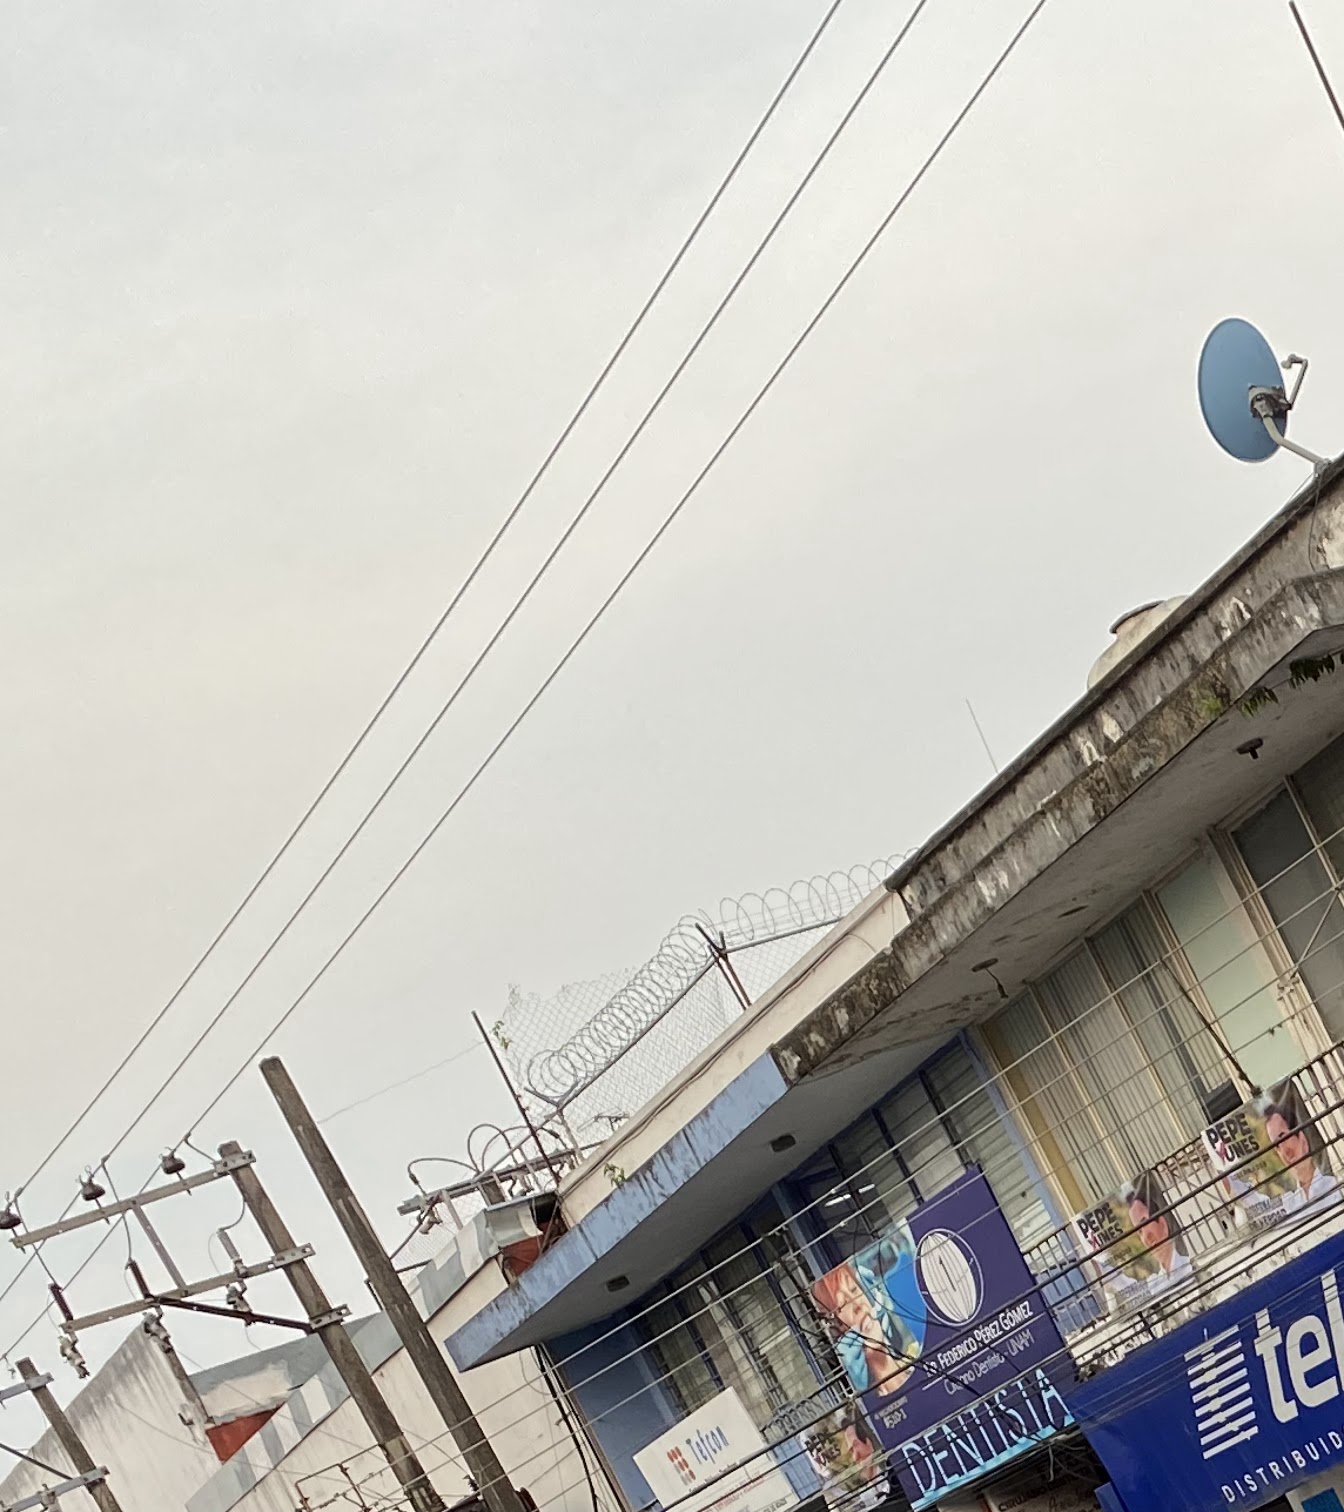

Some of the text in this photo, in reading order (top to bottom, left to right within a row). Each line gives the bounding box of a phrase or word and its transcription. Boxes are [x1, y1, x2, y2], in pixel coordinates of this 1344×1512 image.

[1206, 1111, 1252, 1150] PEPE
[1077, 1201, 1117, 1239] PEPE
[999, 1300, 1034, 1331] GÓMEZ
[901, 1368, 1076, 1496] DENTISTA
